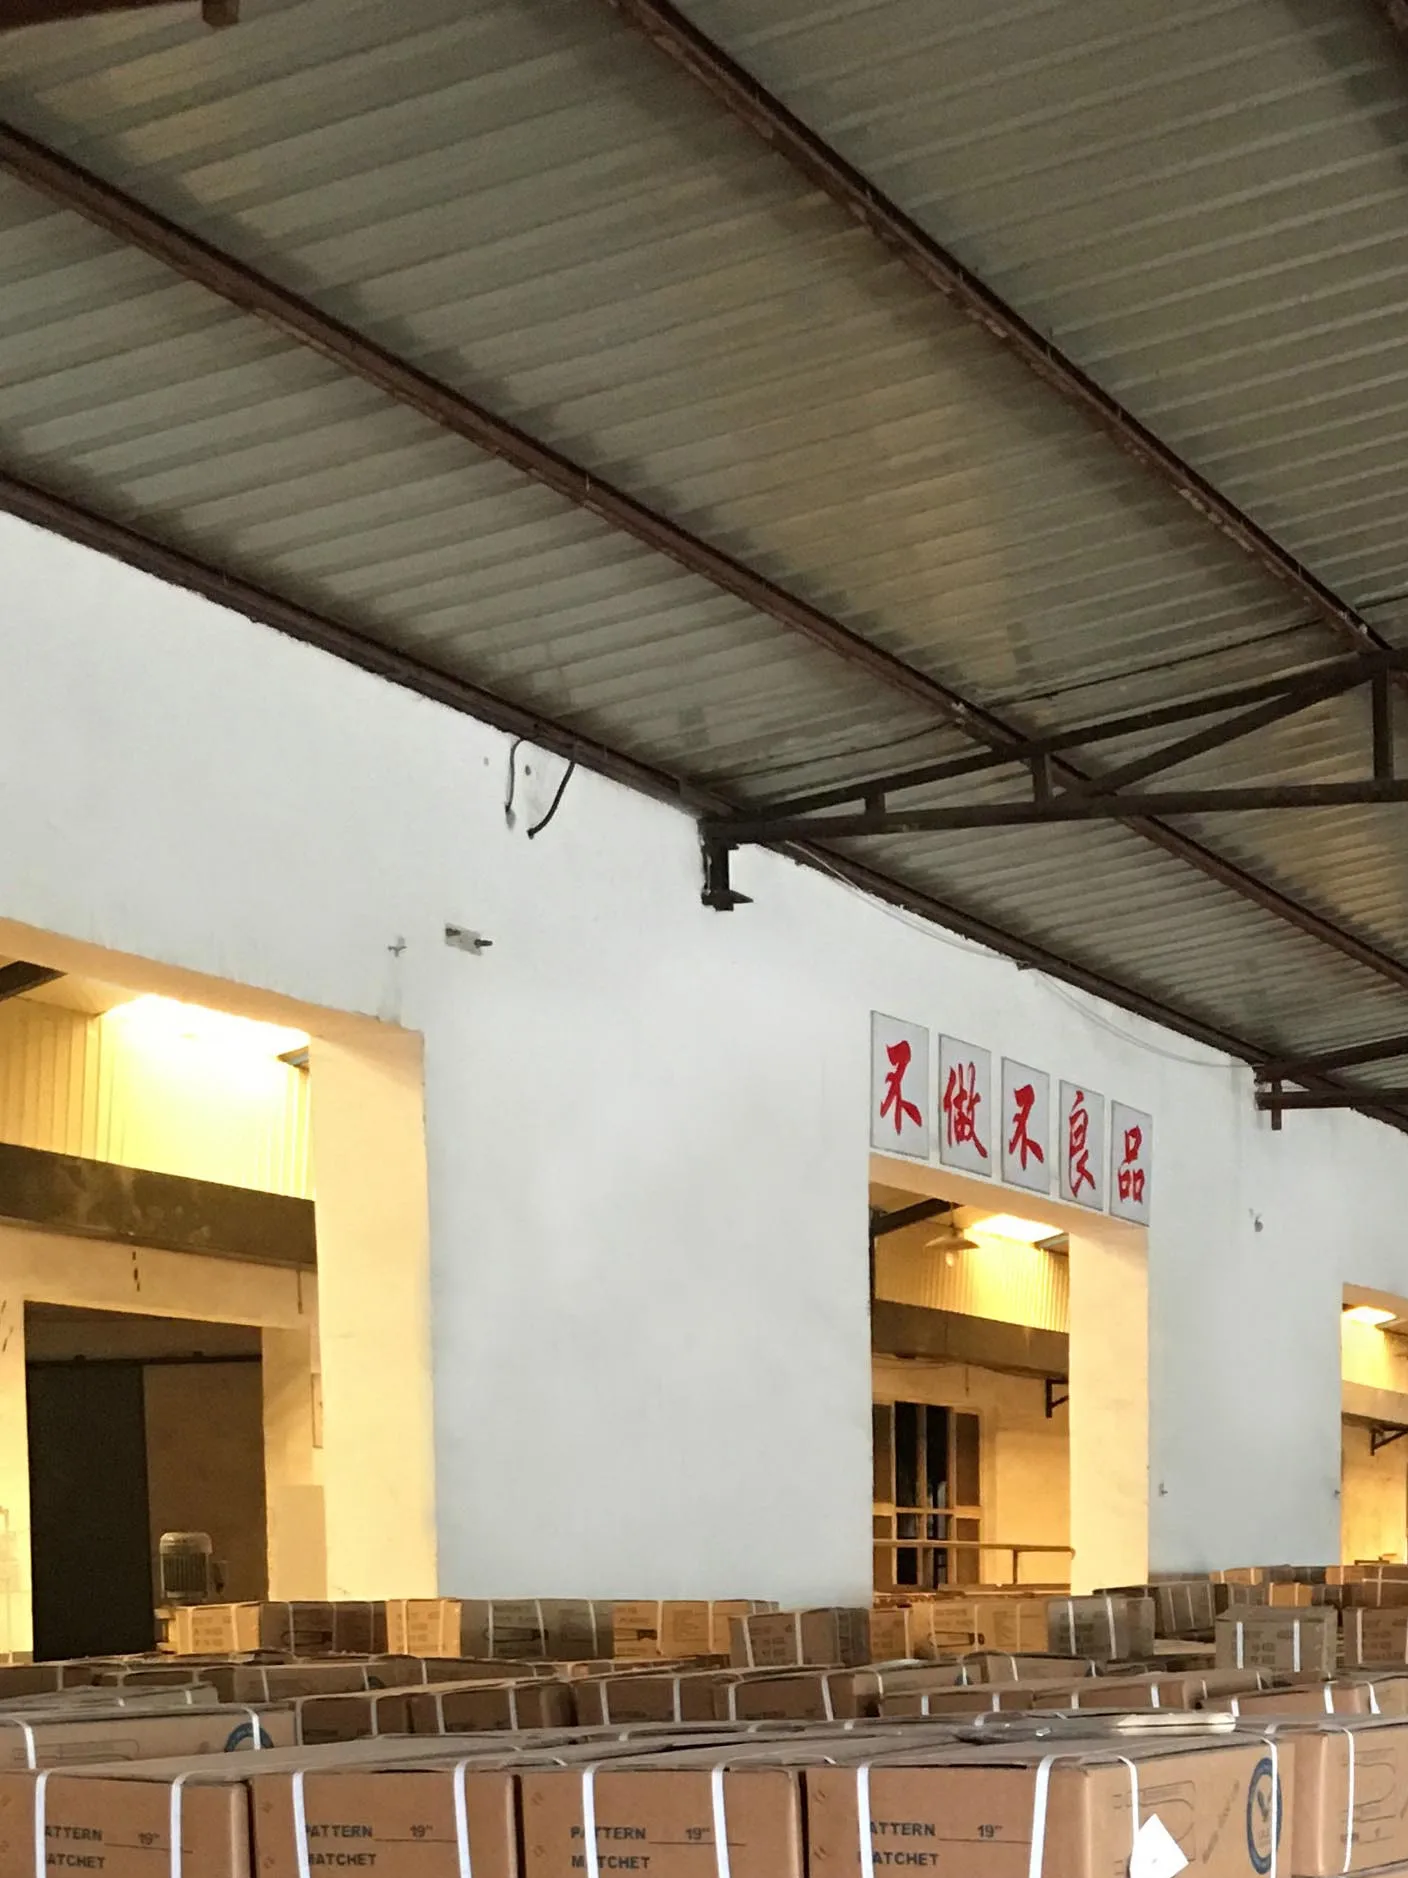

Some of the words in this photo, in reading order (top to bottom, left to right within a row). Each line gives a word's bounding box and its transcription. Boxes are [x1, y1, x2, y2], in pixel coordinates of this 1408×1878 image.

[879, 1039, 1144, 1205] 不做不良品
[44, 1825, 103, 1842] ATTERN
[867, 1823, 936, 1838] ATTERN
[45, 1853, 106, 1869] ATCHET
[571, 1855, 650, 1870] MTCHET
[858, 1852, 940, 1867] ATCHET
